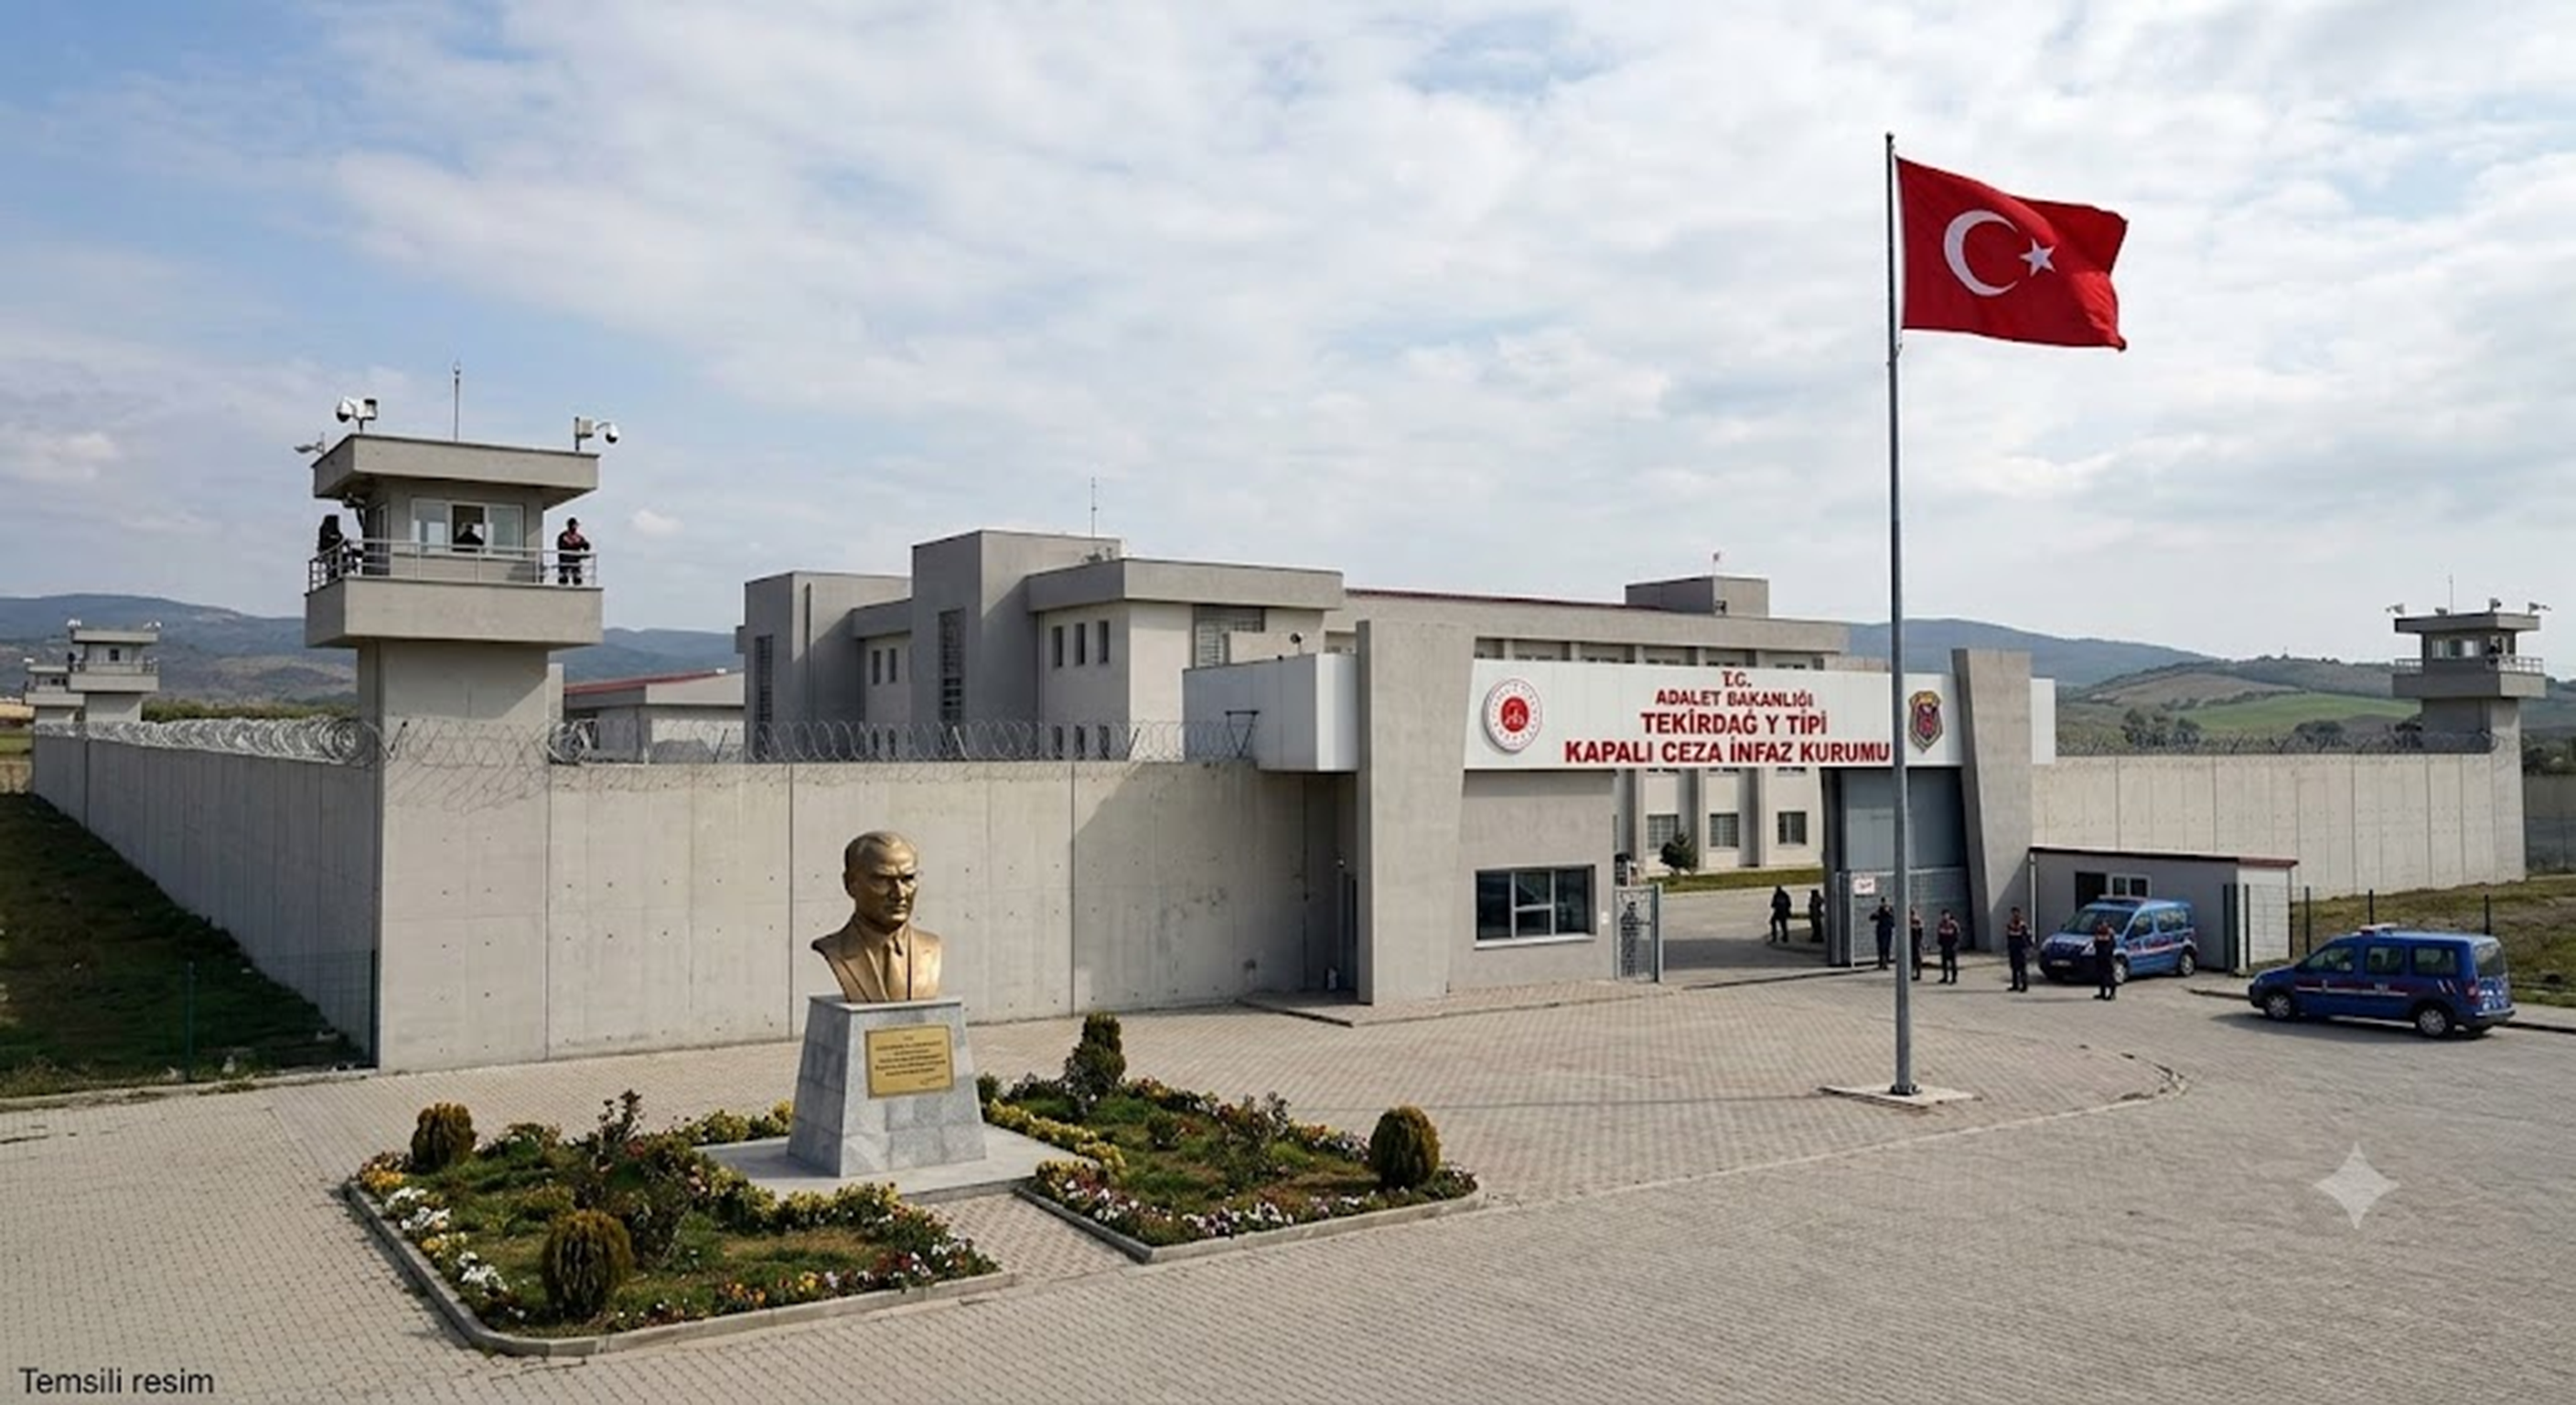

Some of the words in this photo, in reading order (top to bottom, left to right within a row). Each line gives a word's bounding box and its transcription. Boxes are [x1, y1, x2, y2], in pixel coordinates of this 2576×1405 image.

[1722, 670, 1752, 688] T.C.
[1655, 690, 1721, 706] ADALET
[1727, 690, 1814, 707] BAKANLIĞI
[1640, 708, 1758, 735] TEKİRDAĞ
[1765, 714, 1780, 735] Y
[1786, 709, 1828, 735] TİPİ
[1565, 741, 1654, 763] KAPALI
[1661, 741, 1723, 763] CEZA
[1729, 735, 1794, 763] İNFAZ
[1799, 742, 1891, 763] KURUMU
